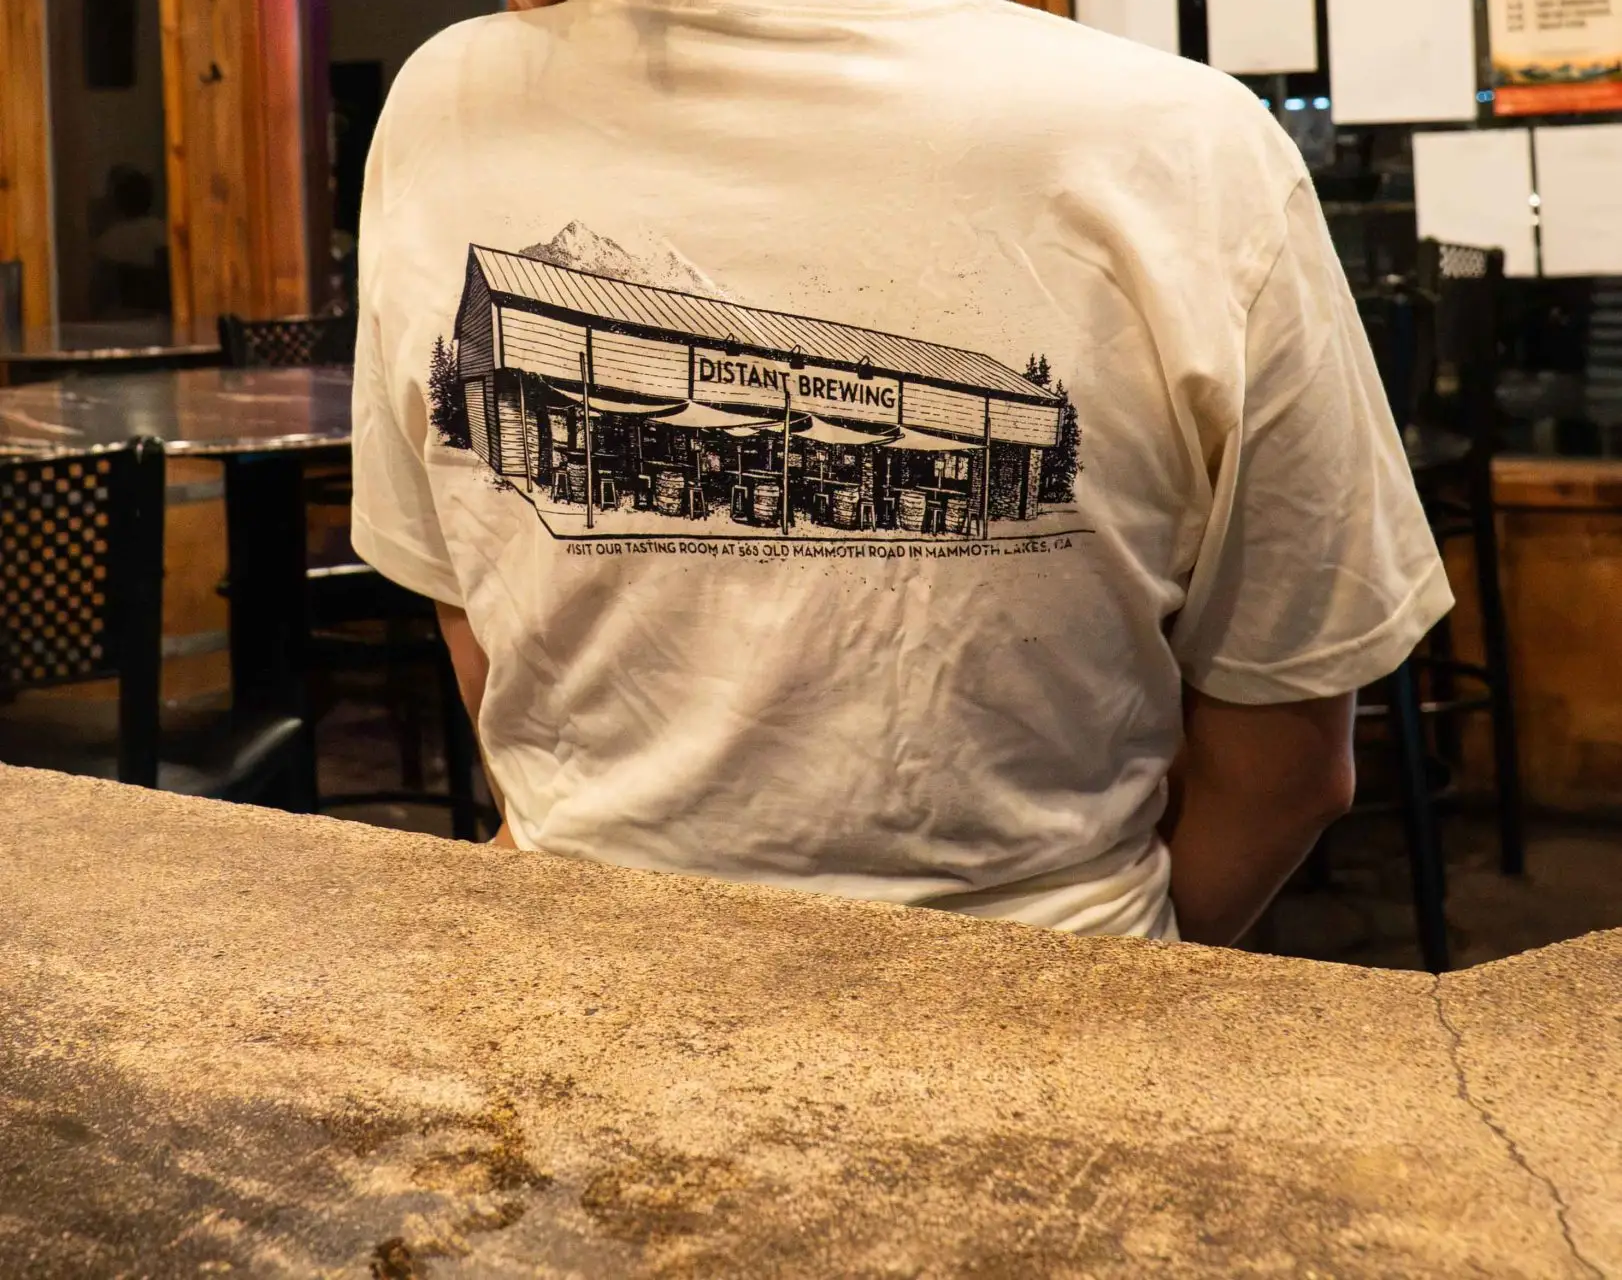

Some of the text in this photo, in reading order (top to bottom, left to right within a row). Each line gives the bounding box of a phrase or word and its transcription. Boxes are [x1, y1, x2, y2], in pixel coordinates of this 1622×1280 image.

[700, 357, 896, 409] DISTANT BREWING
[596, 543, 623, 556] OUR
[624, 541, 676, 555] TASTING
[679, 542, 719, 556] ROOM
[721, 543, 735, 556] AT
[762, 544, 790, 557] OLD
[793, 544, 865, 559] MAMMOTH
[868, 545, 906, 559] ROAD
[909, 545, 923, 558] IN
[925, 543, 1000, 559] MAMMOTH
